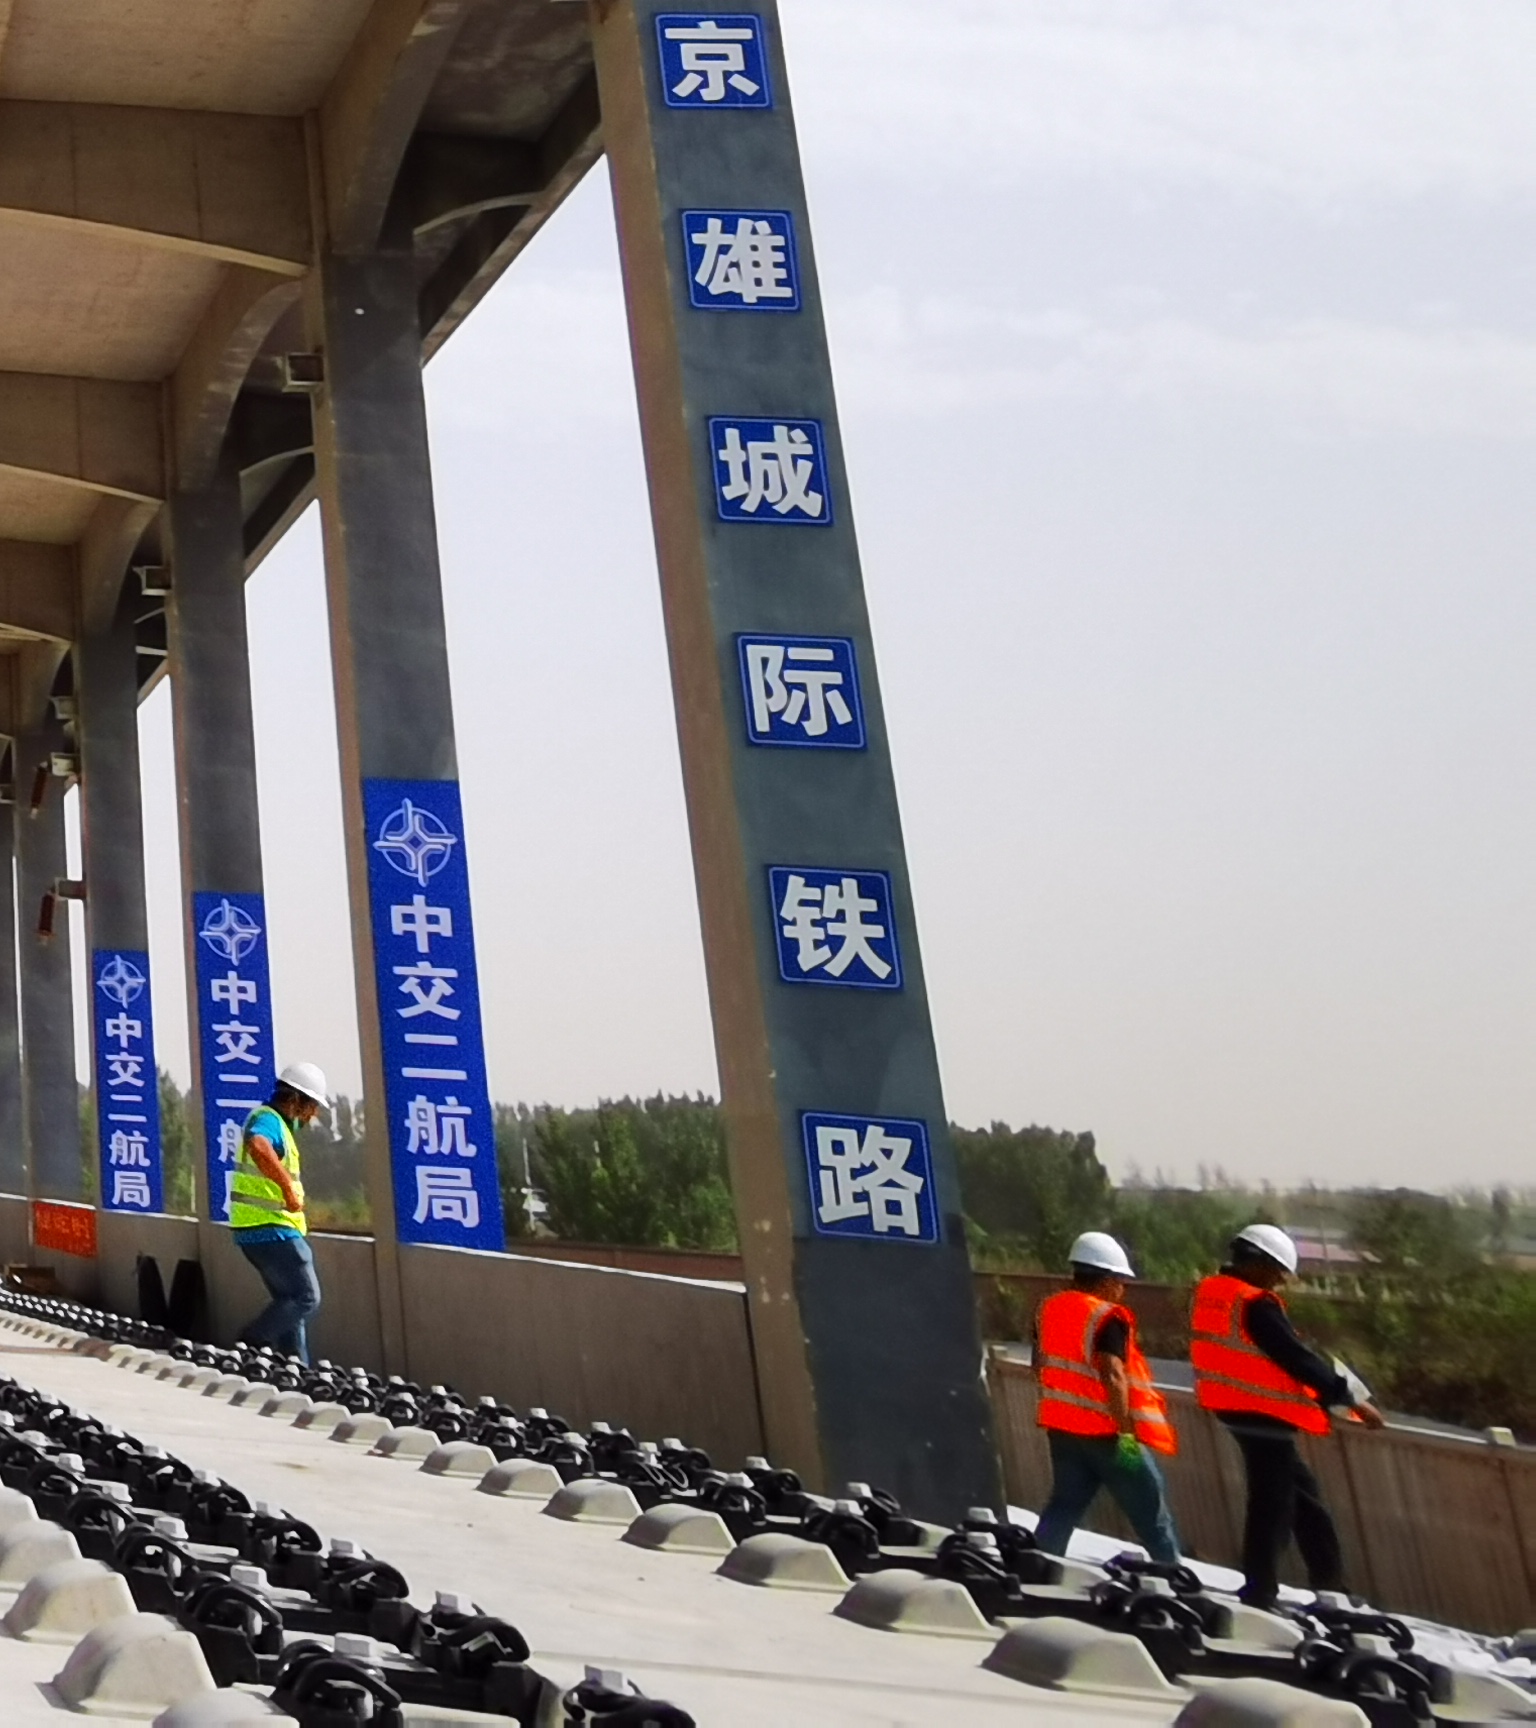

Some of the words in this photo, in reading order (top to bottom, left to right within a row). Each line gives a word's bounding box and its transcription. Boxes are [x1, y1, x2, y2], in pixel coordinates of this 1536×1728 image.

[662, 21, 928, 1237] 京雄城际铁路
[104, 1012, 152, 1209] 中交二航局
[389, 893, 481, 1229] 中交二航局
